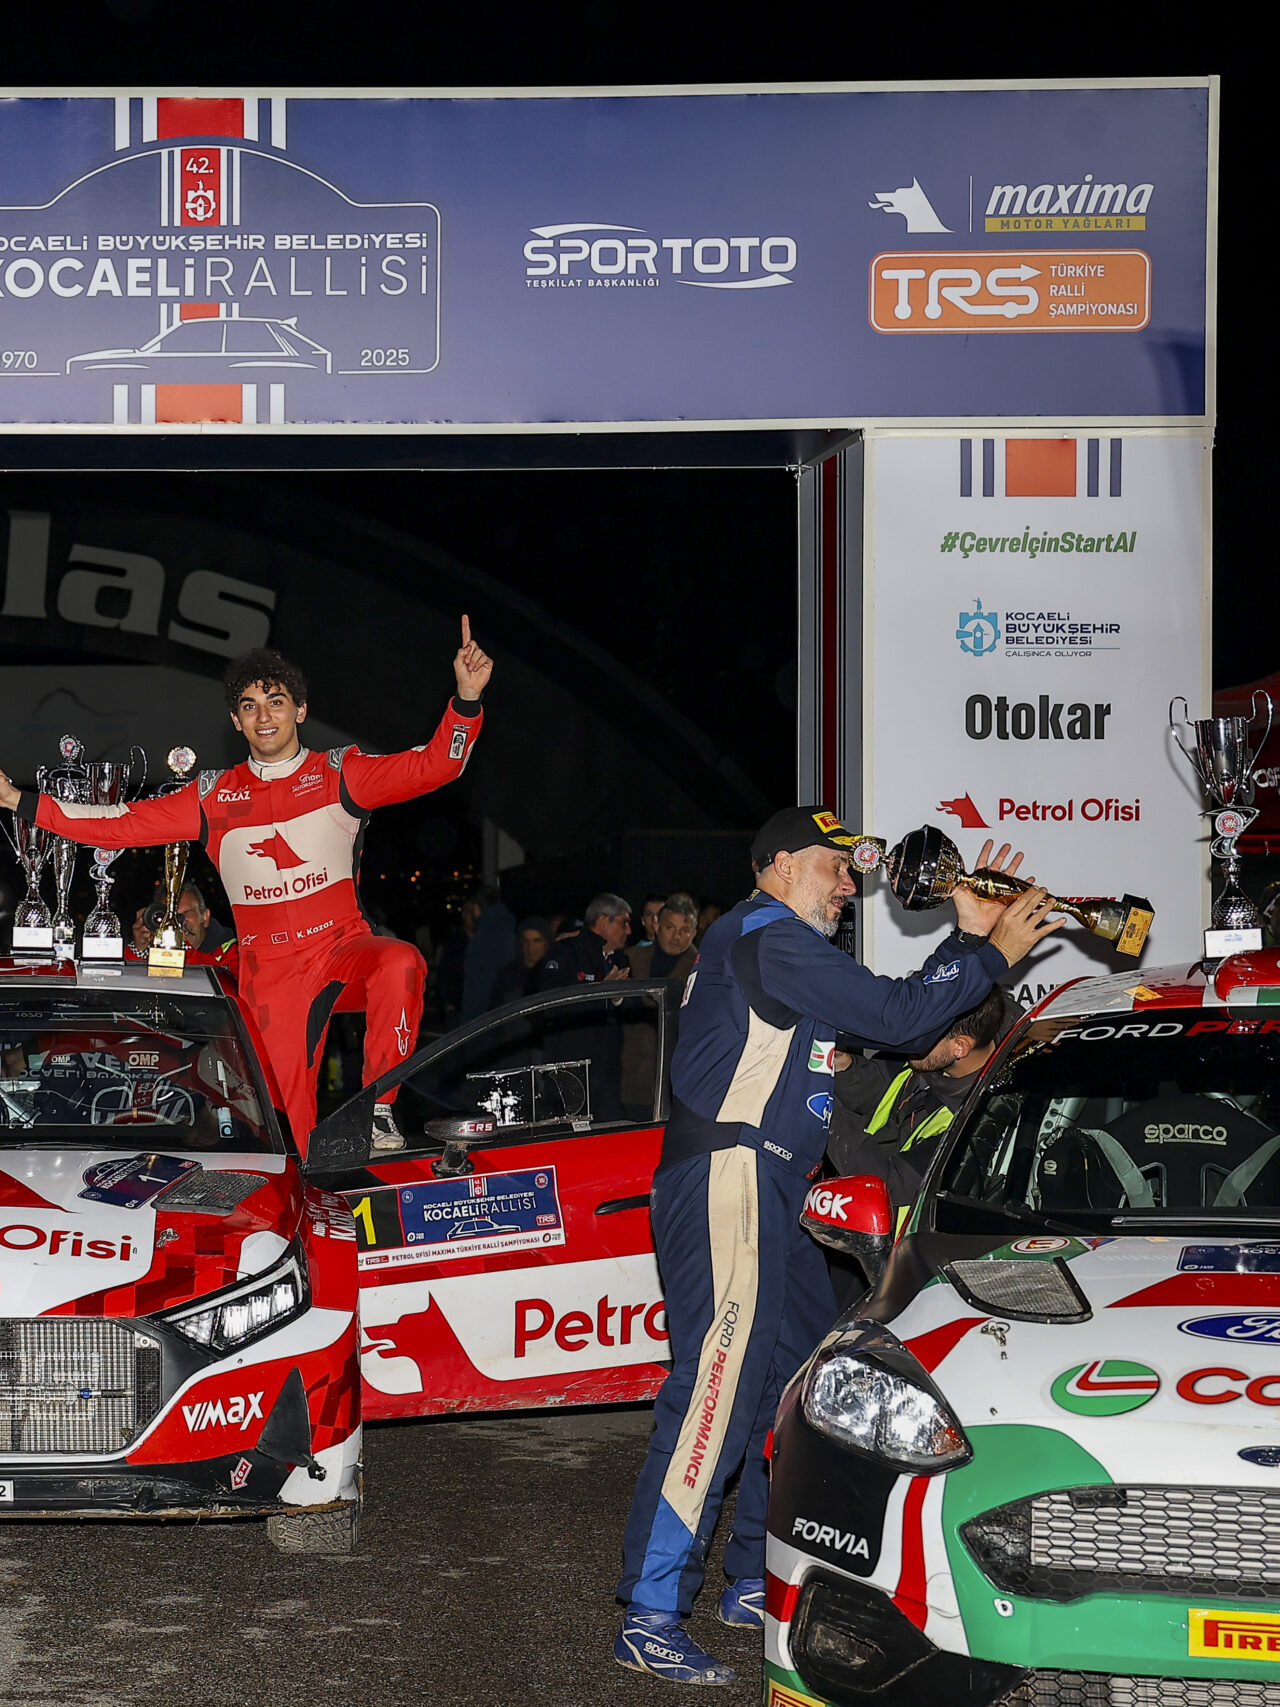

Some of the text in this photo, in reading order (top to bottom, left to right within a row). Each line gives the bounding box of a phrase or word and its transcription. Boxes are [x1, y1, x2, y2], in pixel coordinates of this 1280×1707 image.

[185, 157, 214, 174] 42.
[985, 173, 1154, 217] maxima
[1000, 216, 1131, 231] MOTOR YAĞLARI
[1049, 263, 1105, 279] TÜRKİYE
[525, 277, 660, 290] TEŞKİLAT BAŞKANLIĞI
[881, 262, 1043, 320] TRS
[1049, 281, 1086, 297] RALLİ
[1049, 301, 1138, 319] ŞAMPİYONASI
[360, 349, 410, 367] 2025
[964, 694, 1112, 740] Otokar
[217, 790, 251, 803] KAZAZ
[998, 797, 1140, 822] Petrol Ofisi
[244, 867, 328, 900] Petrol Ofisi
[296, 920, 334, 939] K. Kazaz
[1051, 1022, 1184, 1044] FORD
[128, 1054, 159, 1066] OMP
[1144, 1123, 1228, 1144] sparco
[764, 1140, 793, 1160] sparco
[804, 1189, 853, 1221] NGK
[353, 1196, 376, 1245] 1
[537, 1215, 556, 1224] TRS
[392, 1253, 414, 1262] PETROL
[432, 1247, 455, 1257] MAXIMA
[457, 1243, 482, 1254] TÜRKİYE
[483, 1240, 499, 1250] RALLİ
[515, 1294, 670, 1358] Petro
[683, 1300, 740, 1489] FORD PERFORMANCE
[792, 1516, 871, 1560] FORVIA
[644, 1640, 685, 1662] sparco
